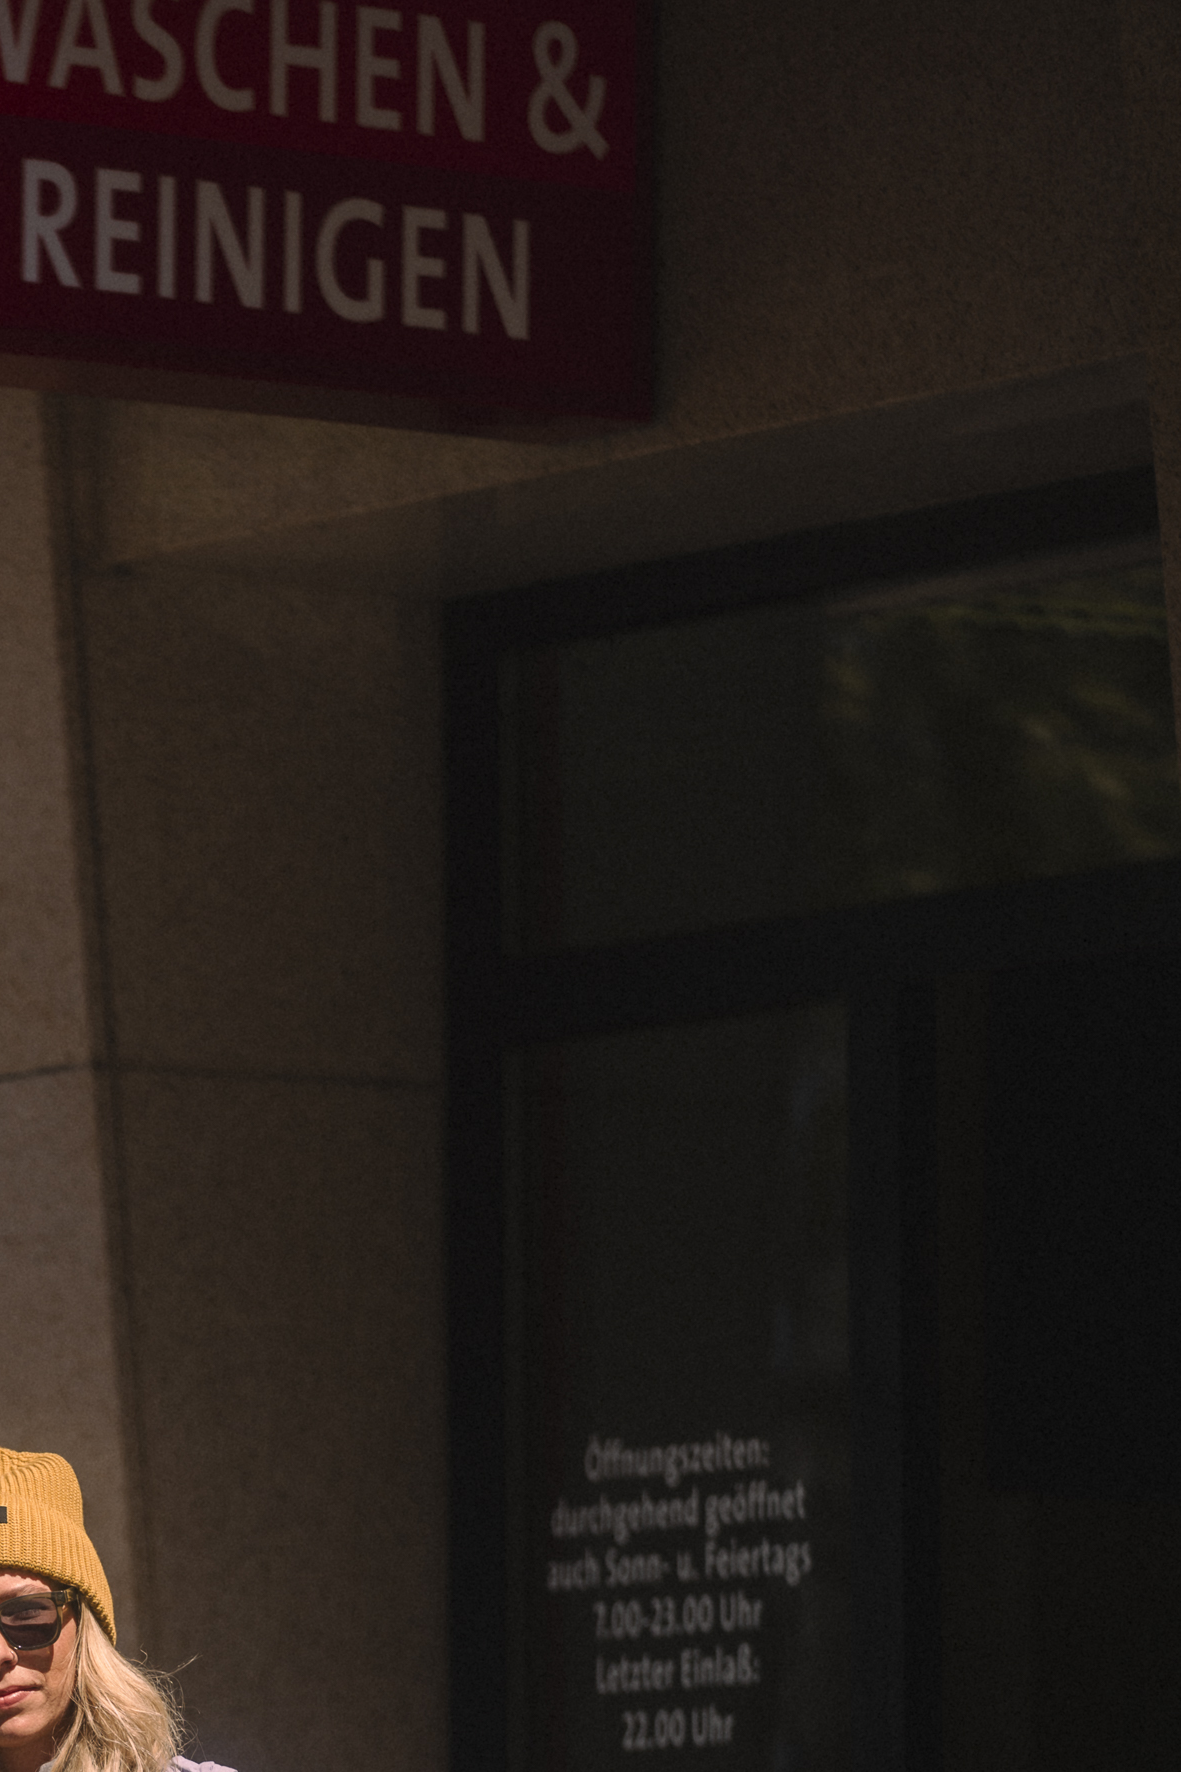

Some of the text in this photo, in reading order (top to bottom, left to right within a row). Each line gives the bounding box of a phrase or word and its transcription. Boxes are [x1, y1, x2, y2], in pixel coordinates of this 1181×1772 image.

[526, 20, 610, 160] &
[21, 157, 531, 341] REINIGEN
[550, 1479, 806, 1545] durchgehend geöffnet
[546, 1548, 600, 1592] auch
[704, 1538, 813, 1588] Feiertags
[719, 1590, 763, 1632] Uhr
[595, 1654, 675, 1695] Letzter
[622, 1704, 735, 1751] 22.00 Uhr
